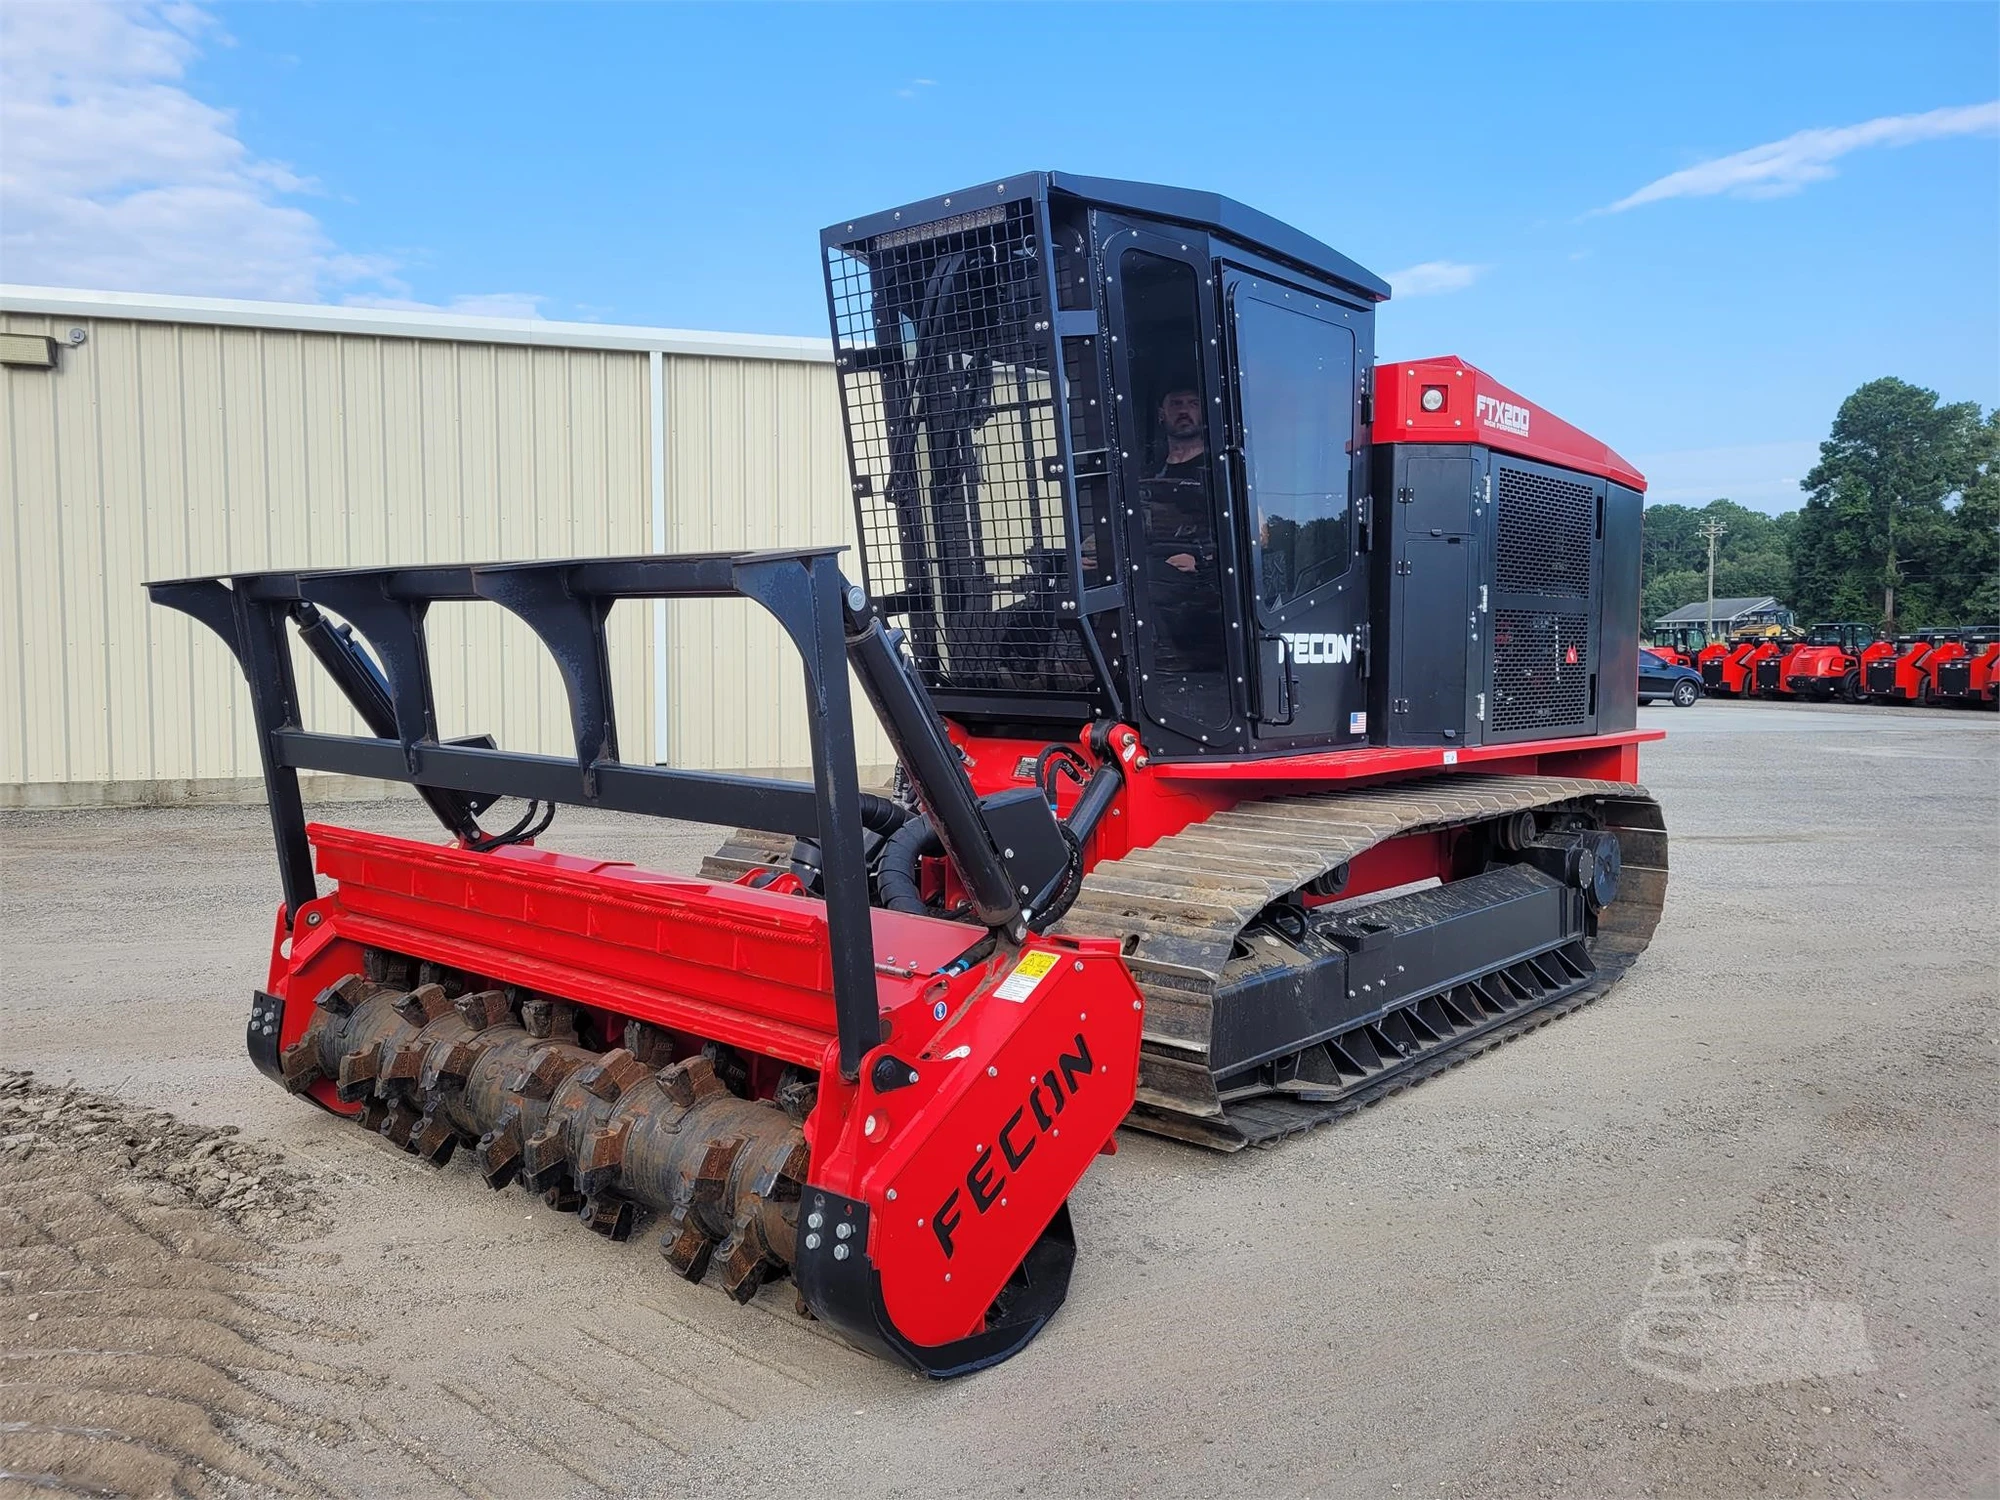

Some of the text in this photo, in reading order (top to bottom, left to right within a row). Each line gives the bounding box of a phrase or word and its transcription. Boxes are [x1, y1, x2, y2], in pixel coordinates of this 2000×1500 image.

[1476, 394, 1530, 431] FTX200
[1279, 633, 1352, 664] FECON
[932, 1032, 1094, 1260] FECON
